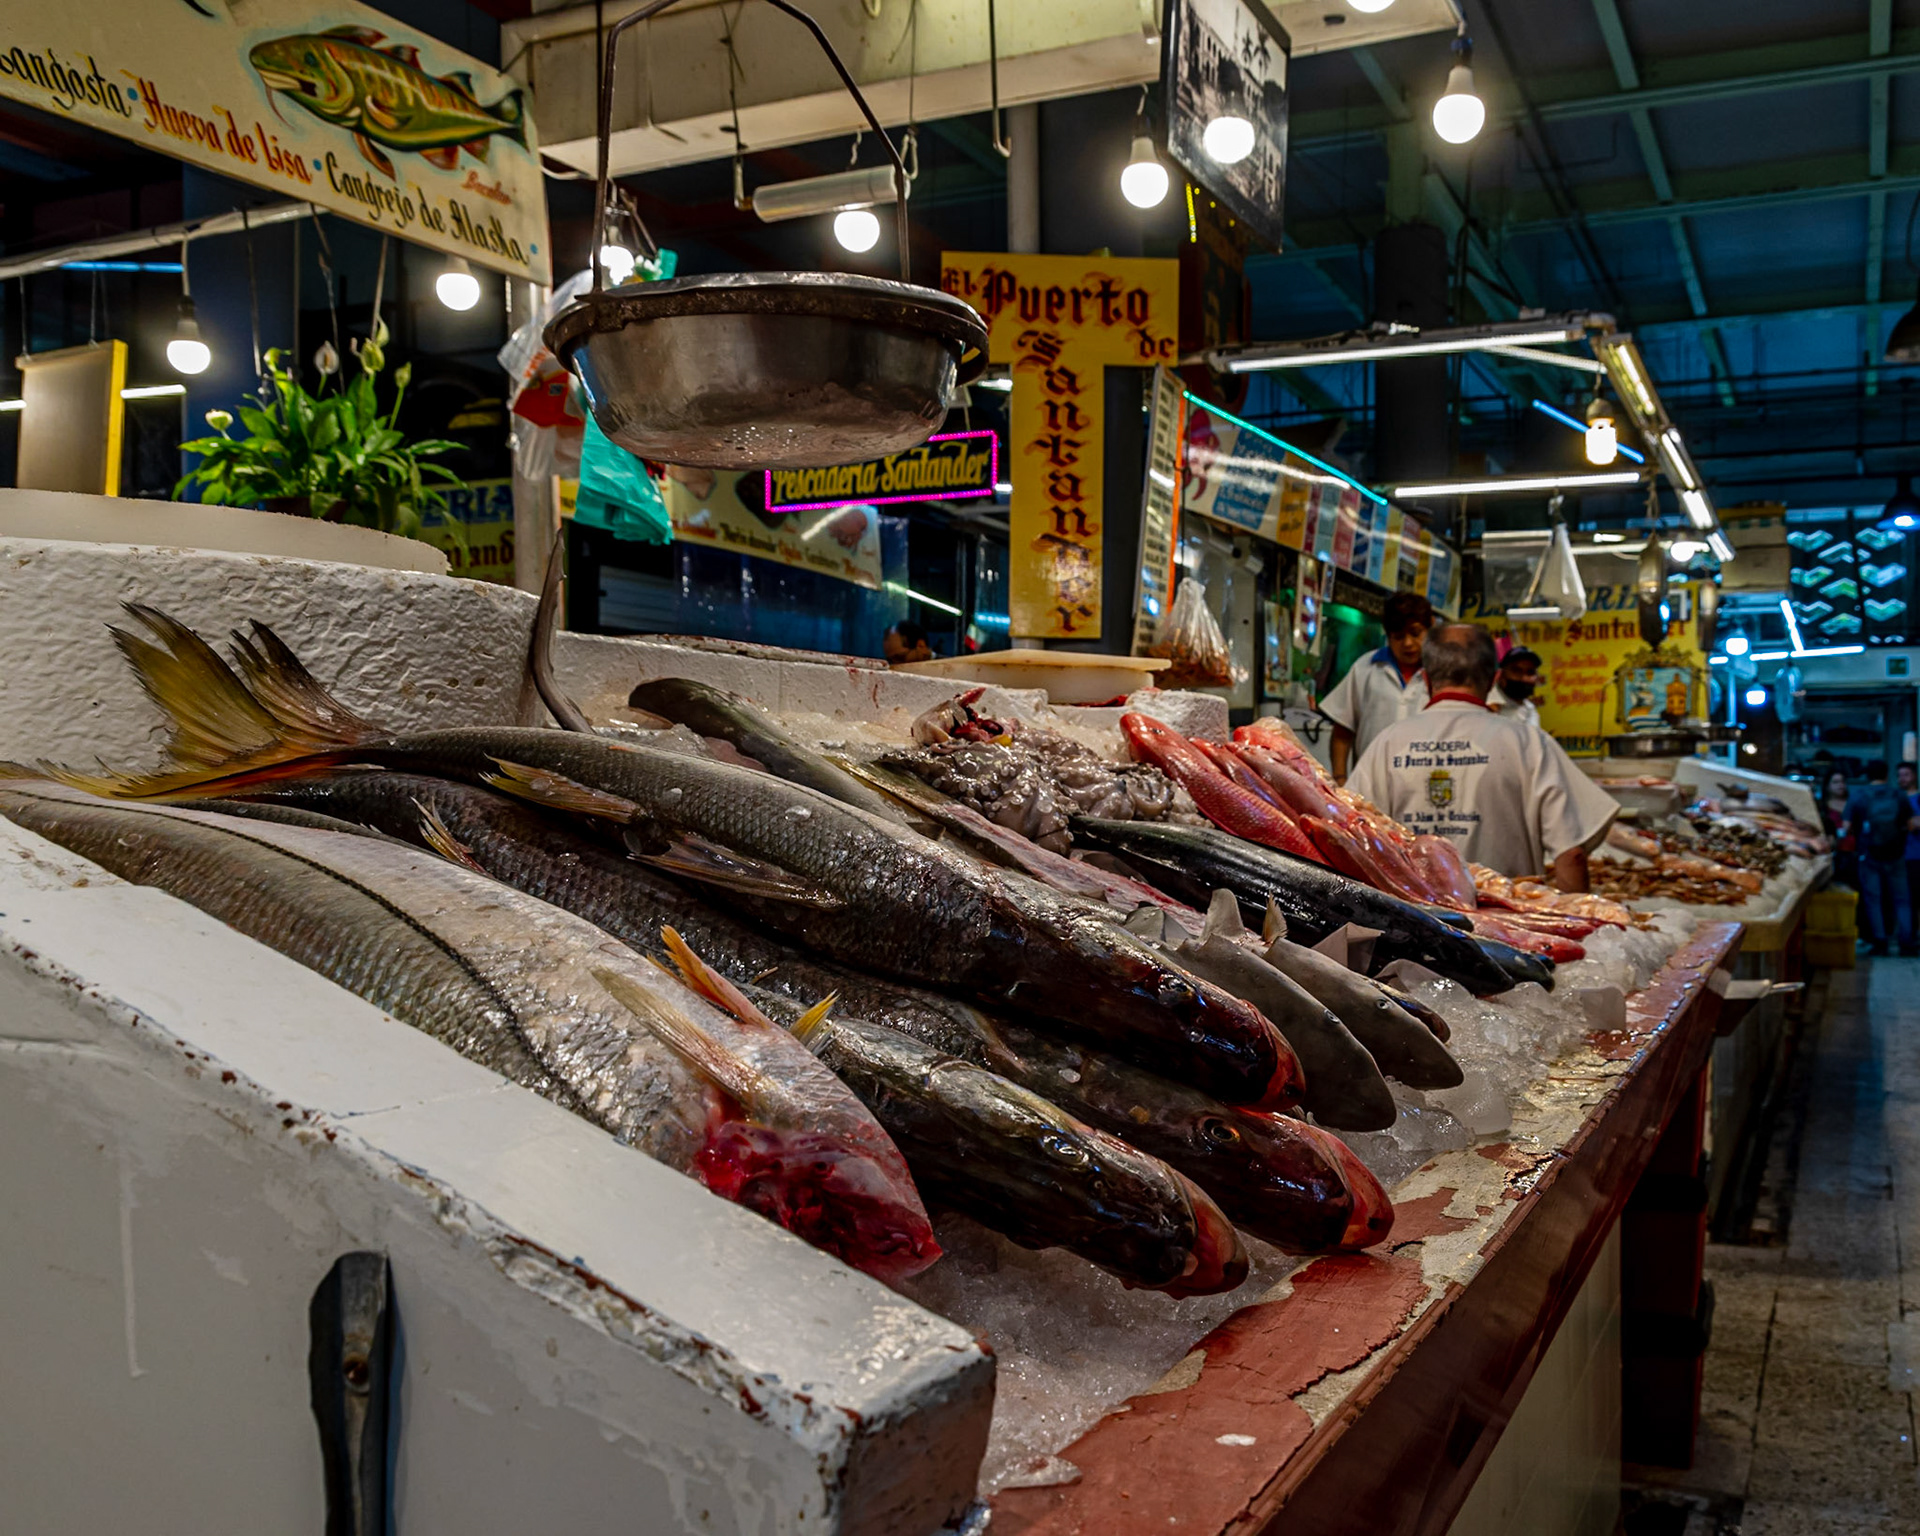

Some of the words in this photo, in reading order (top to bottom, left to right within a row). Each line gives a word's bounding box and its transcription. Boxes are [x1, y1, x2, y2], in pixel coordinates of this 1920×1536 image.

[136, 75, 224, 152] Hueva
[213, 105, 258, 163] de
[256, 122, 312, 184] Lisa
[326, 151, 415, 229] Cangrejo
[415, 185, 446, 233] de
[980, 265, 1150, 328] Puerto
[1135, 327, 1174, 358] de
[882, 441, 990, 494] Santander
[1405, 755, 1432, 769] Puerto
[1436, 755, 1444, 766] de
[1447, 754, 1489, 766] Santander
[1410, 741, 1471, 751] PESCADERIA
